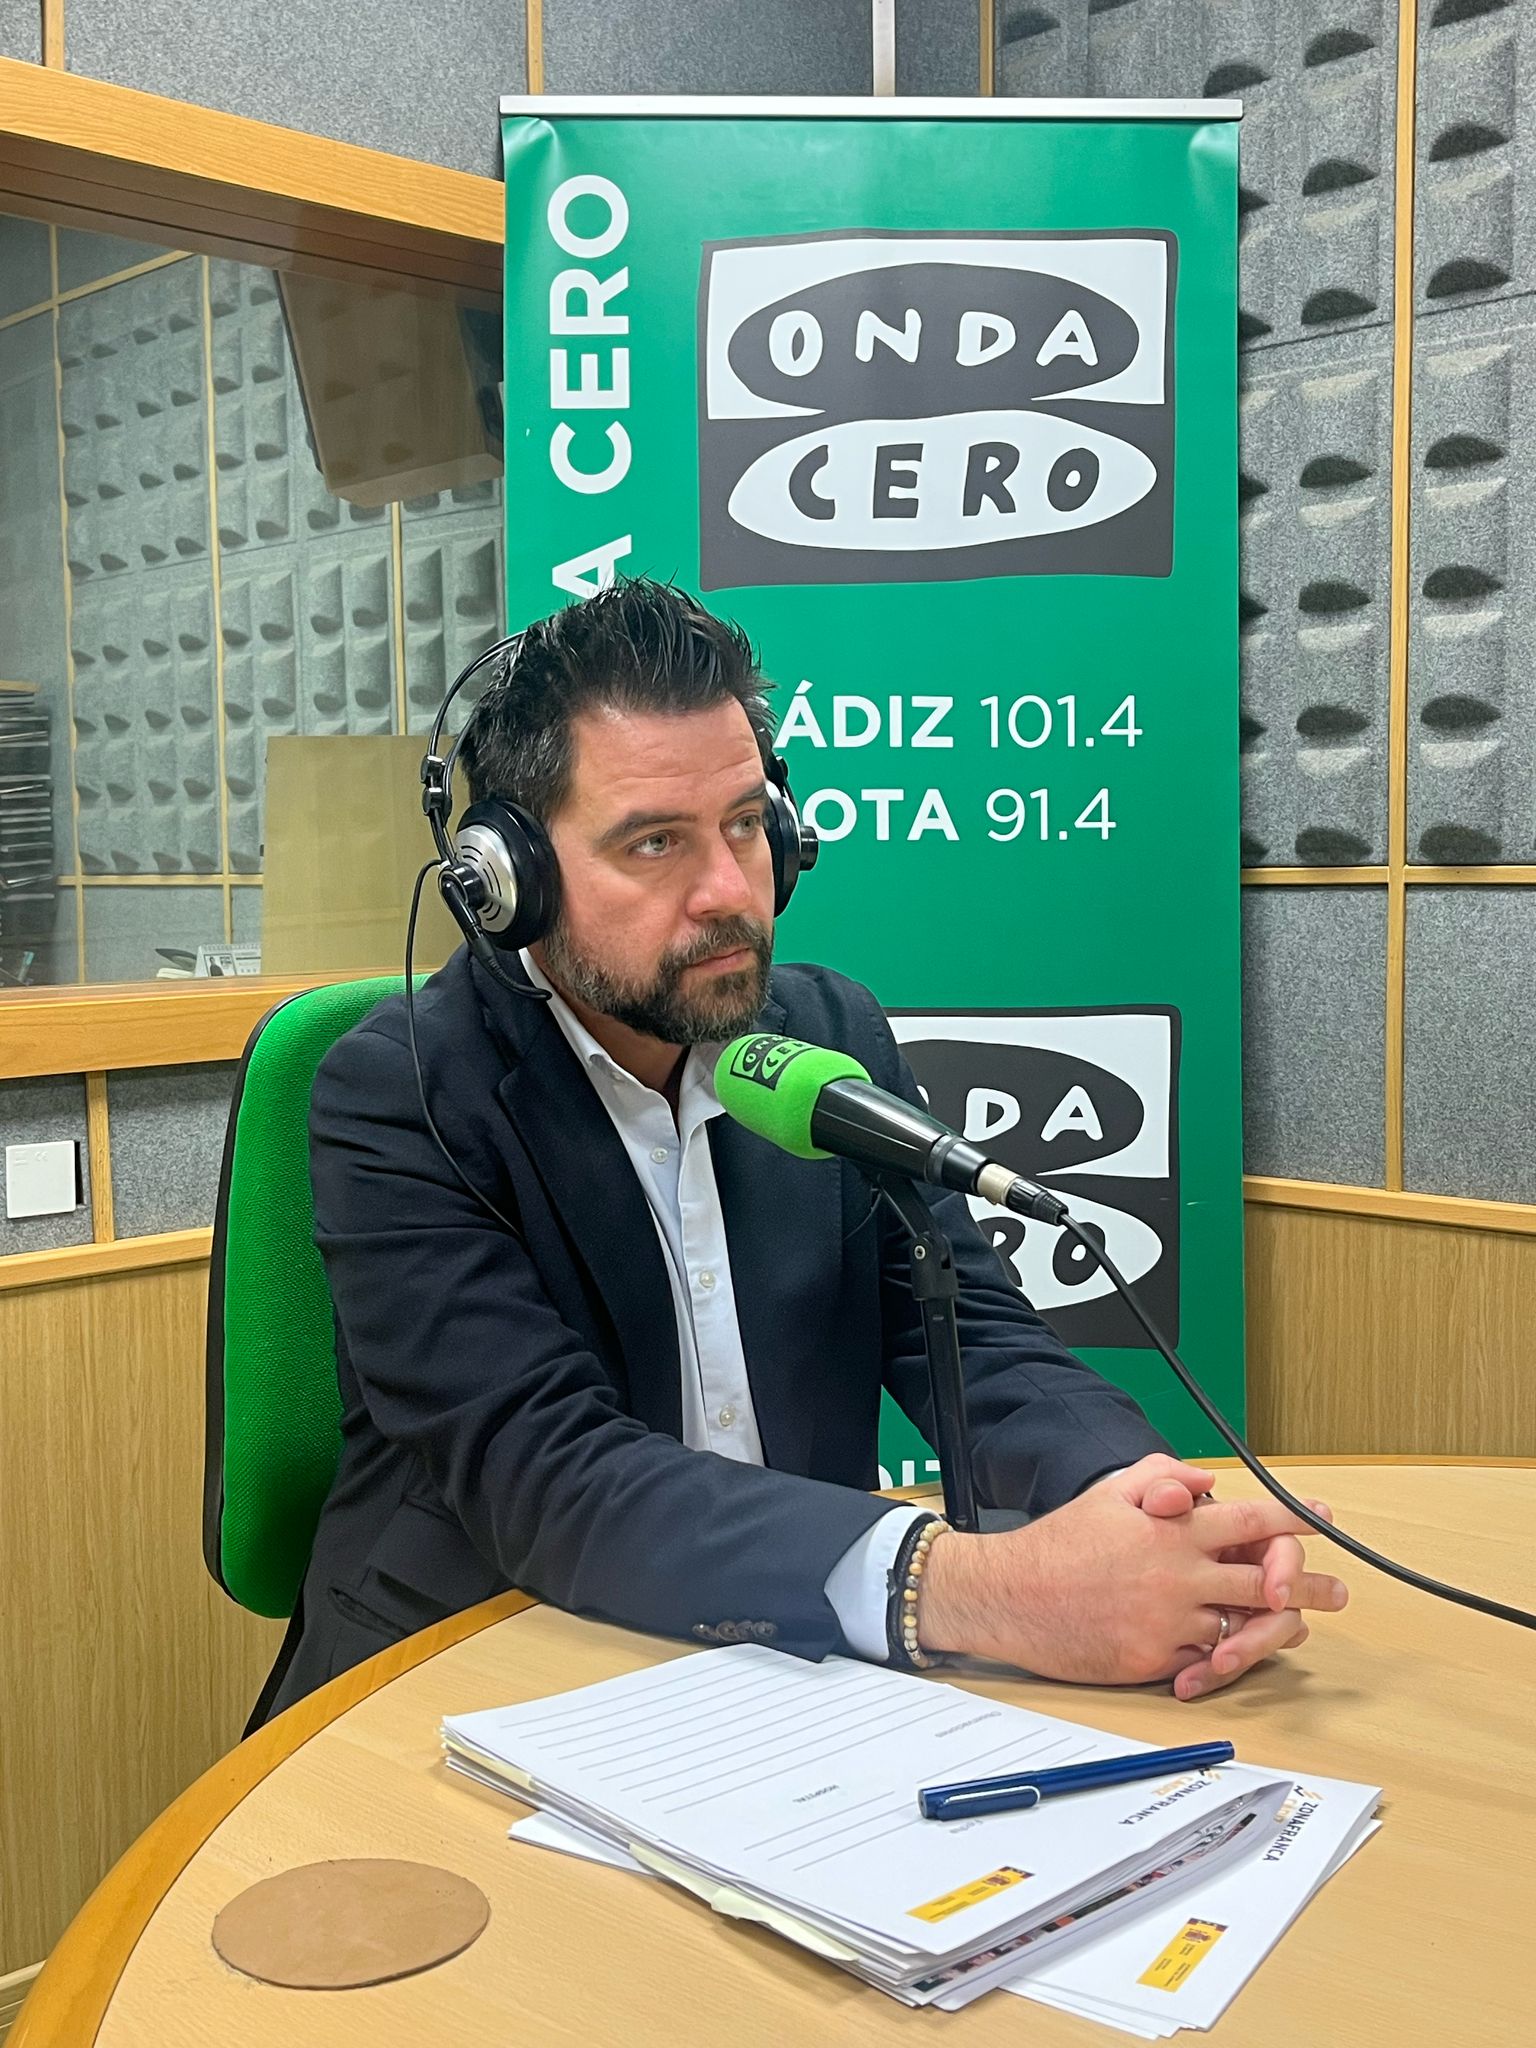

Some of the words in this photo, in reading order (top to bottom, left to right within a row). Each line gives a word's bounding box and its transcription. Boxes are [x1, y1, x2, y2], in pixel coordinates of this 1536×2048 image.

[547, 174, 633, 495] CERO
[768, 308, 1100, 377] ONDA
[788, 441, 1102, 521] CERO
[773, 679, 954, 748] ÁDIZ
[979, 694, 1143, 748] 101.4
[802, 788, 960, 842] OTA
[985, 788, 1117, 842] 91.4
[963, 1085, 1104, 1142] DA
[976, 1216, 1106, 1287] RO
[1118, 1780, 1212, 1825] ZONAFRANCA
[1262, 1801, 1319, 1861] ZONAFRANCA
